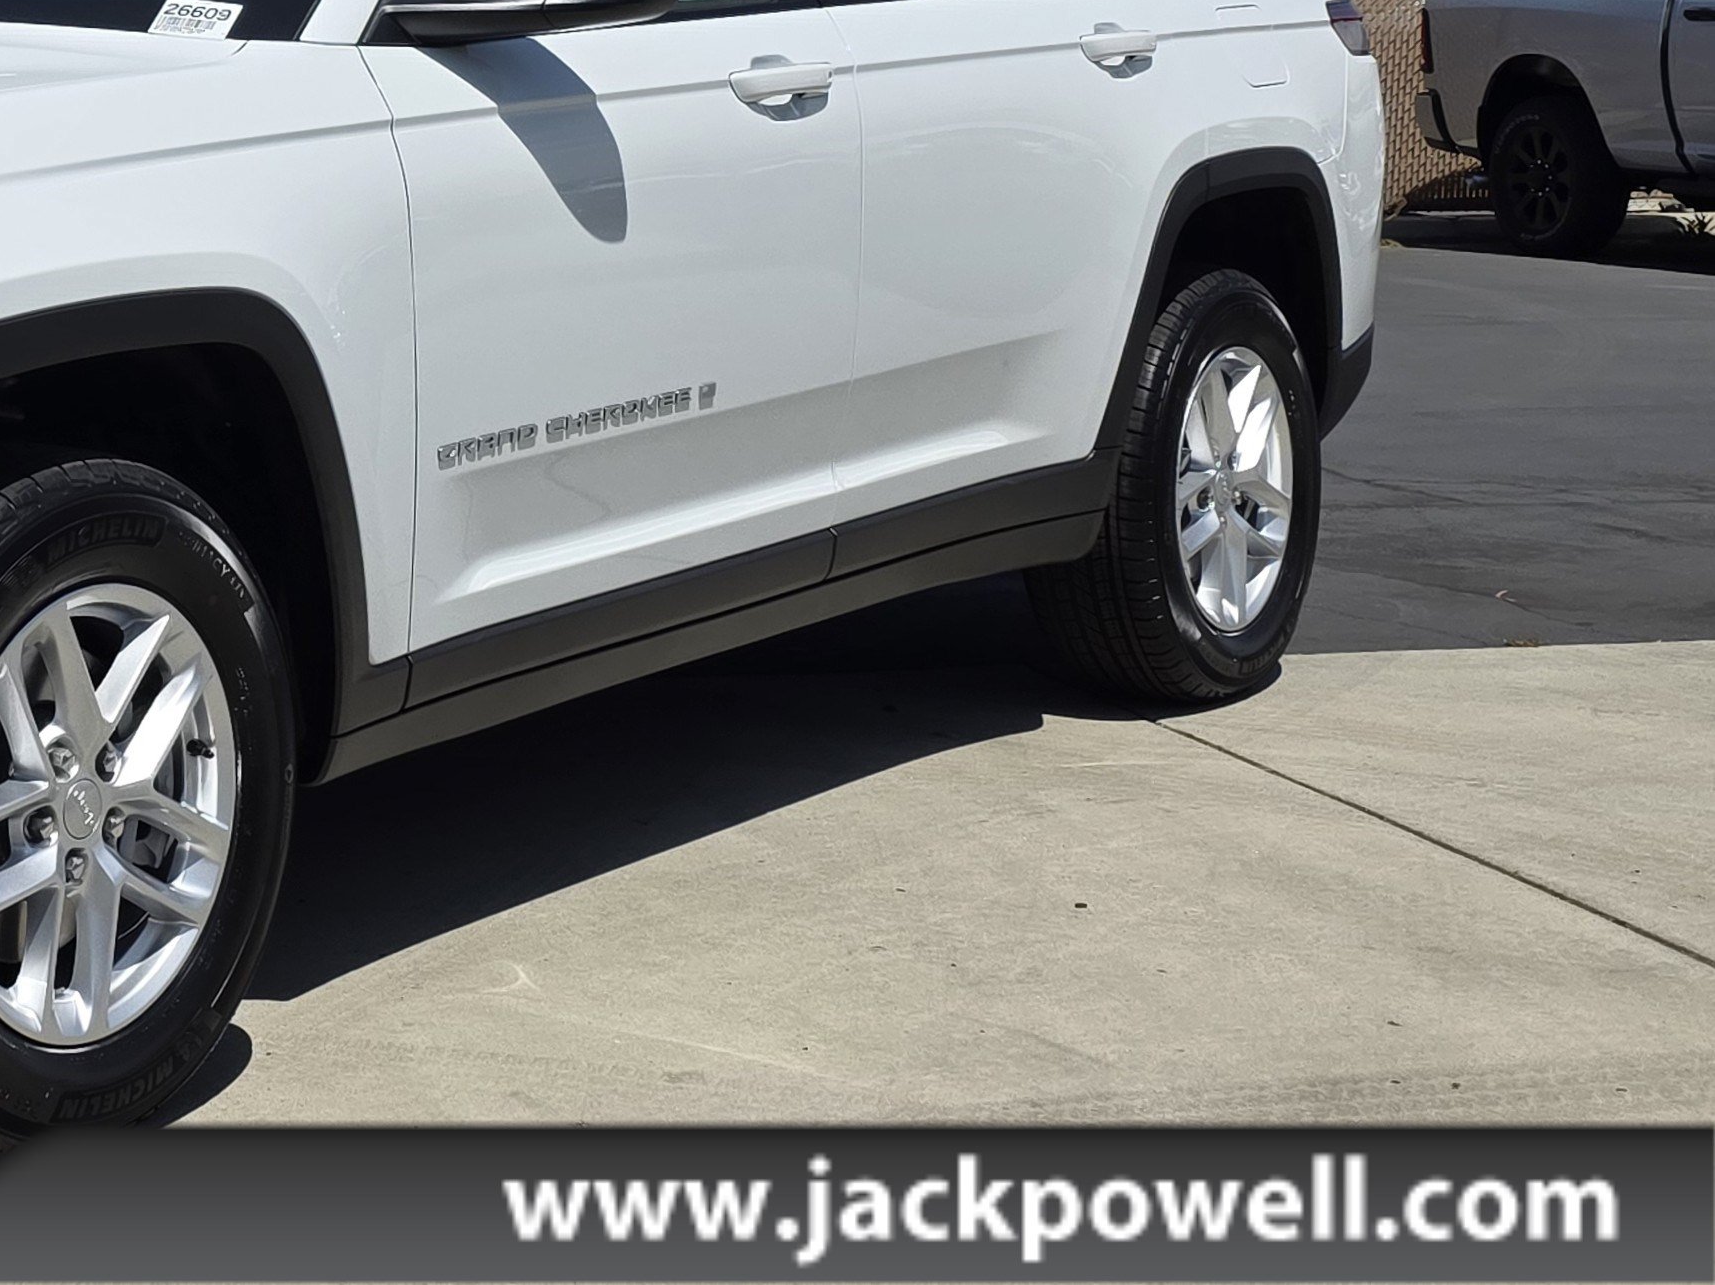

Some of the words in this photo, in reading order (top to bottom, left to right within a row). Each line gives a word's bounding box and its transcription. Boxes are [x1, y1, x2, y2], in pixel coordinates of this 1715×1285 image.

[163, 3, 232, 21] 26609
[437, 423, 538, 471] GRAND
[545, 387, 692, 444] CHEROKEE
